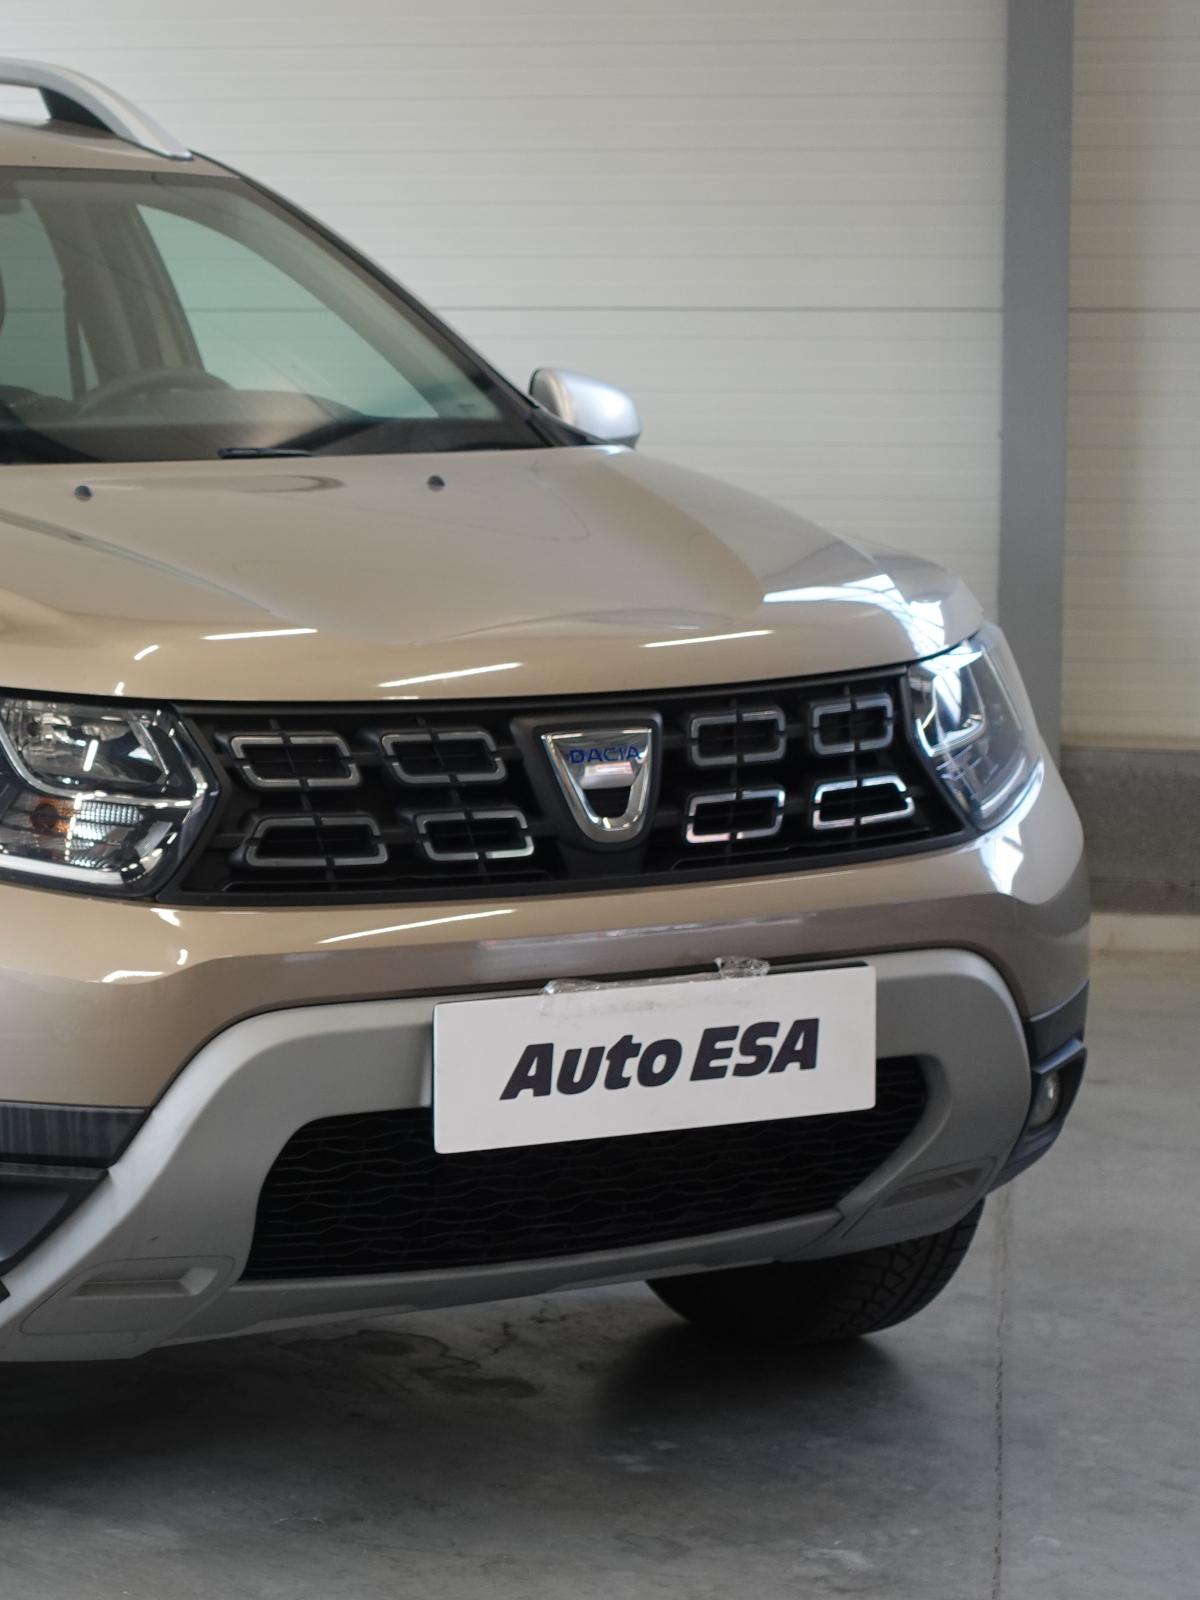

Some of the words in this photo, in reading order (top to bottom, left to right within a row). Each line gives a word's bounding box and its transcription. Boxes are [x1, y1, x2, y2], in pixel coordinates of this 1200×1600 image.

[569, 746, 642, 764] DACIA
[499, 1034, 683, 1101] Auto
[689, 1017, 820, 1082] ESA
